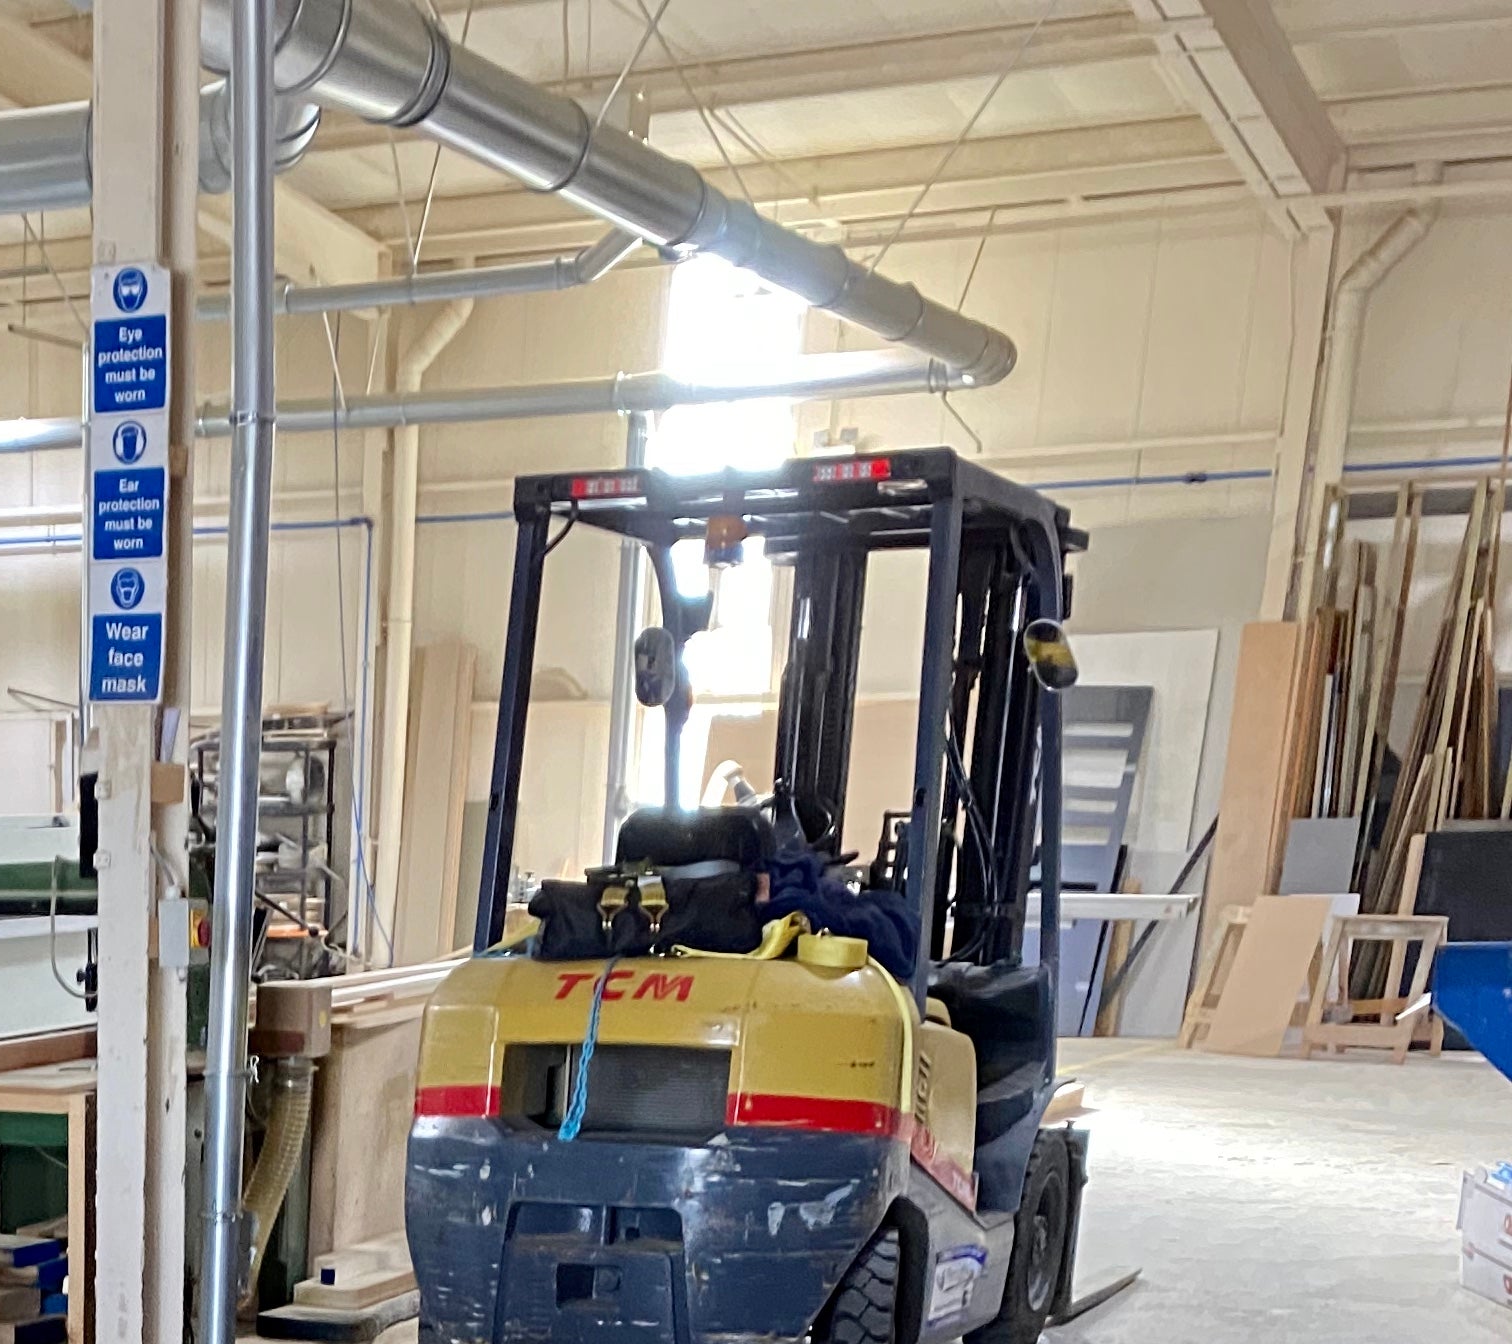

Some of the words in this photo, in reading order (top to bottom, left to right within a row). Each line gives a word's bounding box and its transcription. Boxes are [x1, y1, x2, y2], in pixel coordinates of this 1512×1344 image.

[119, 326, 143, 345] Eye
[98, 345, 163, 368] protection
[105, 367, 136, 384] must
[139, 366, 156, 382] be
[114, 389, 146, 404] worn
[119, 478, 140, 494] Ear
[98, 497, 160, 516] protection
[104, 517, 135, 532] must
[137, 515, 153, 531] be
[113, 538, 144, 550] worn
[105, 621, 150, 641] Wear
[108, 646, 144, 668] face
[101, 674, 147, 694] mask
[554, 970, 695, 1003] TCM
